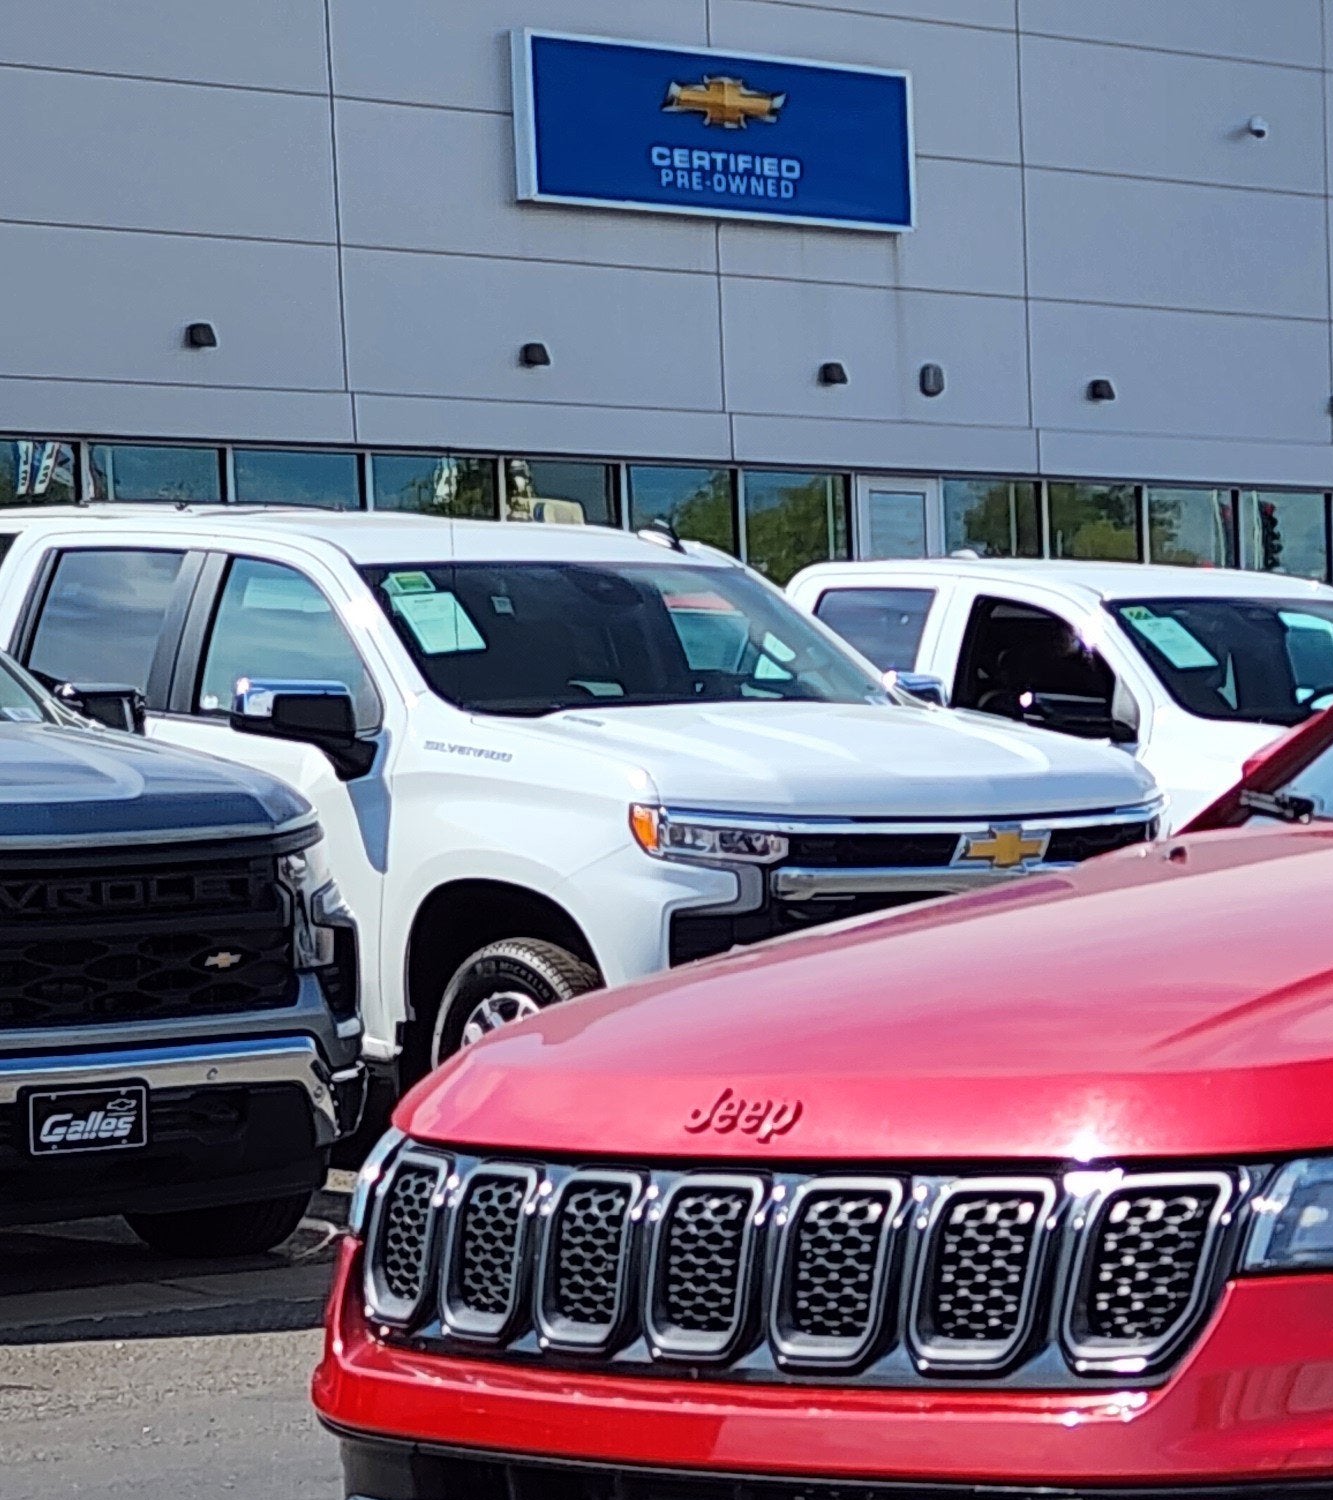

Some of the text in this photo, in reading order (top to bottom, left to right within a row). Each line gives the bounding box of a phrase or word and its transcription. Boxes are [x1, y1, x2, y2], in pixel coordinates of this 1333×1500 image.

[651, 146, 801, 180] CERTIFIED
[660, 168, 794, 199] PRE-OWNED
[40, 1110, 137, 1143] Galles
[684, 1087, 804, 1145] Jeep
